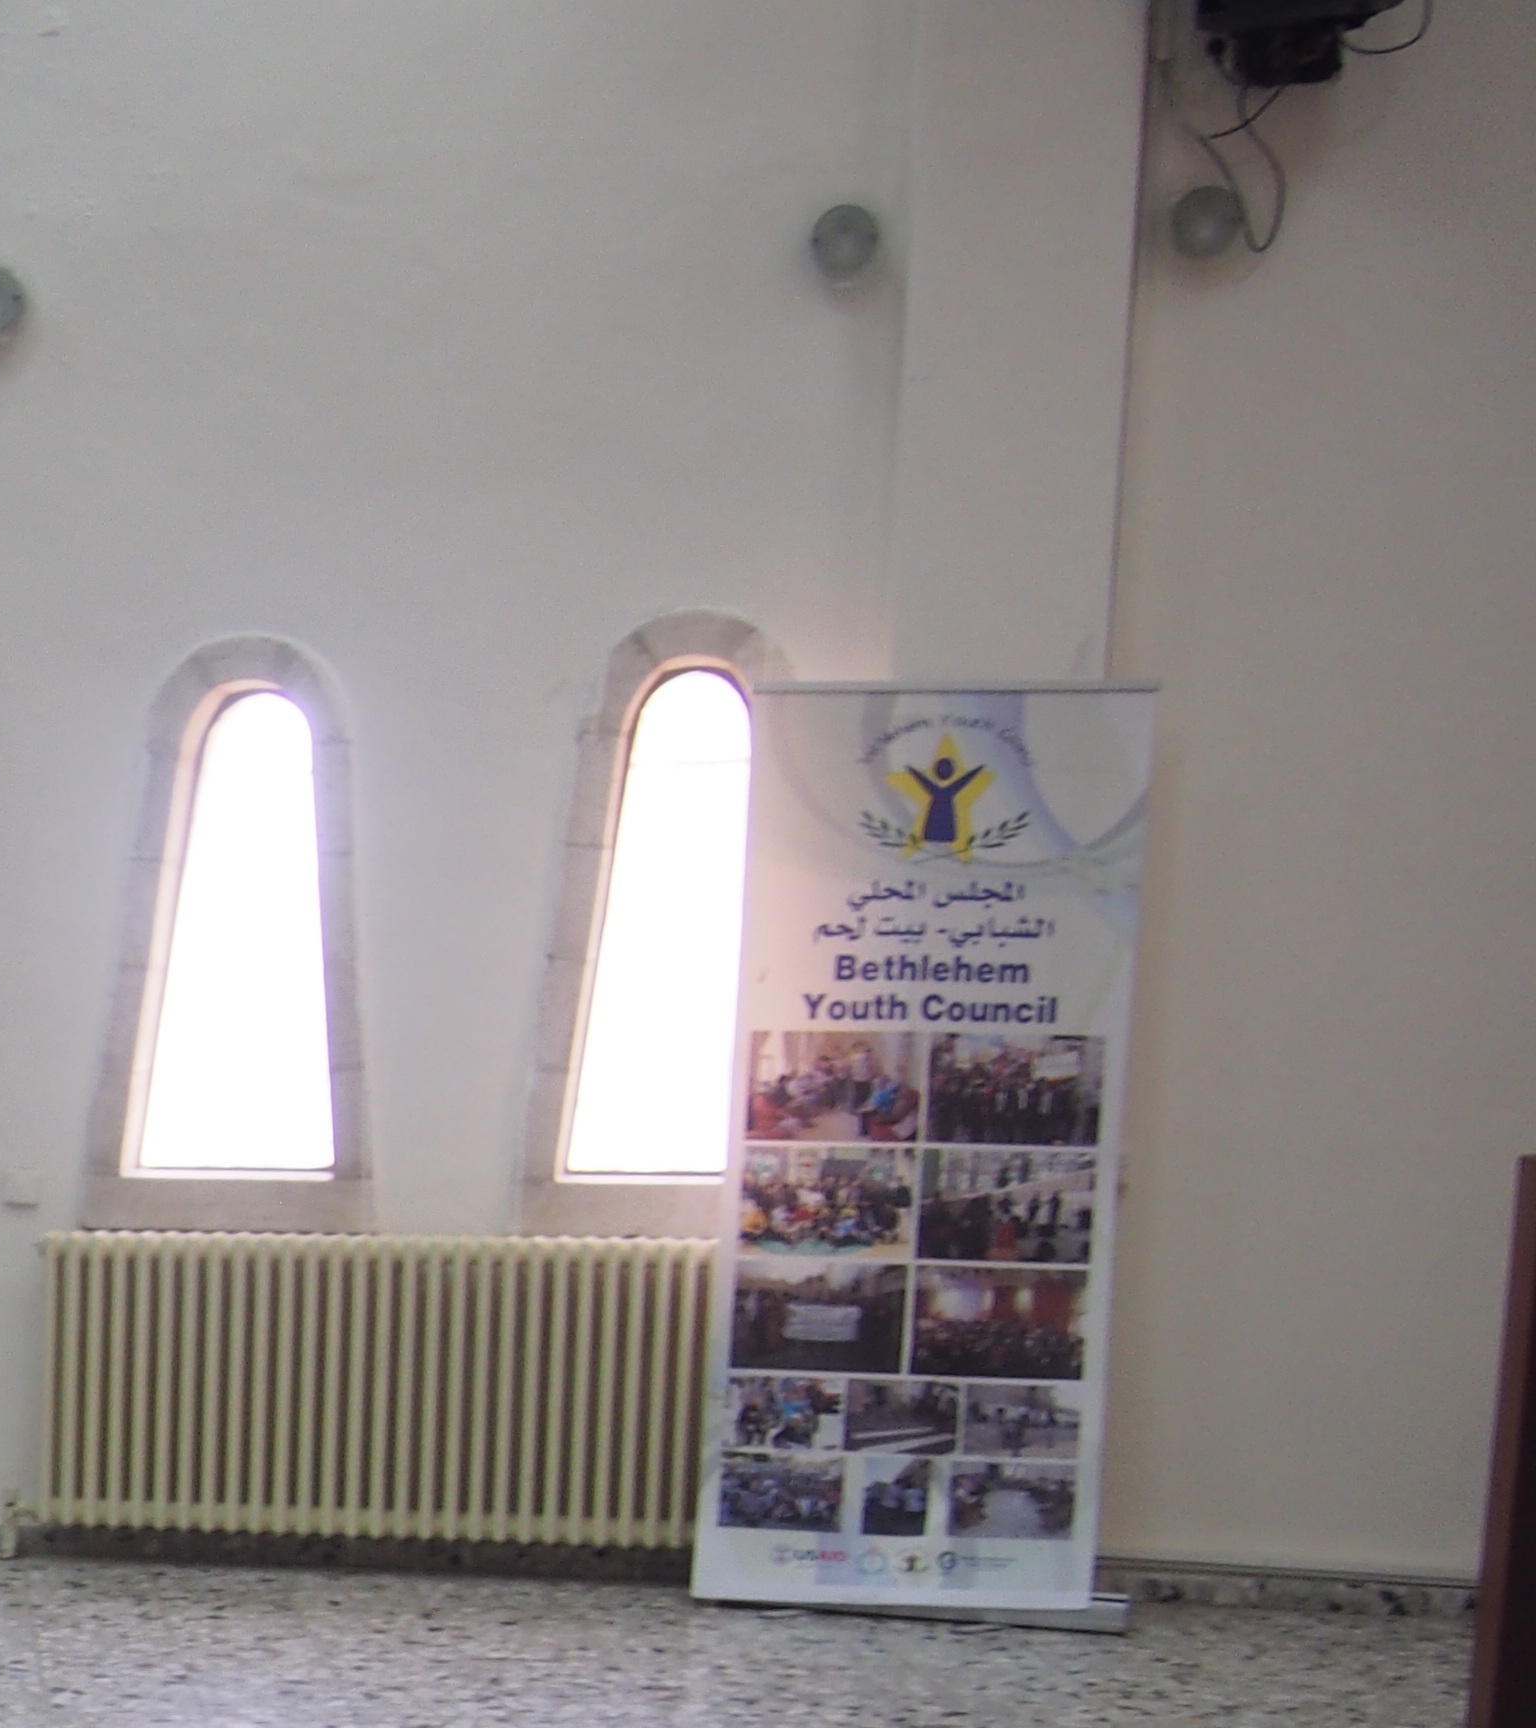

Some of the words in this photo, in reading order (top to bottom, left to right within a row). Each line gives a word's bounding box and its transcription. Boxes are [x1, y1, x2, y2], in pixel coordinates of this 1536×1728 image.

[845, 880, 926, 912] المحلي
[931, 880, 1026, 910] المجلس
[812, 915, 867, 945] لحم
[874, 916, 928, 944] بيت
[834, 954, 1030, 985] Bethlehem
[802, 992, 908, 1021] Youth
[919, 993, 1060, 1025] Council
